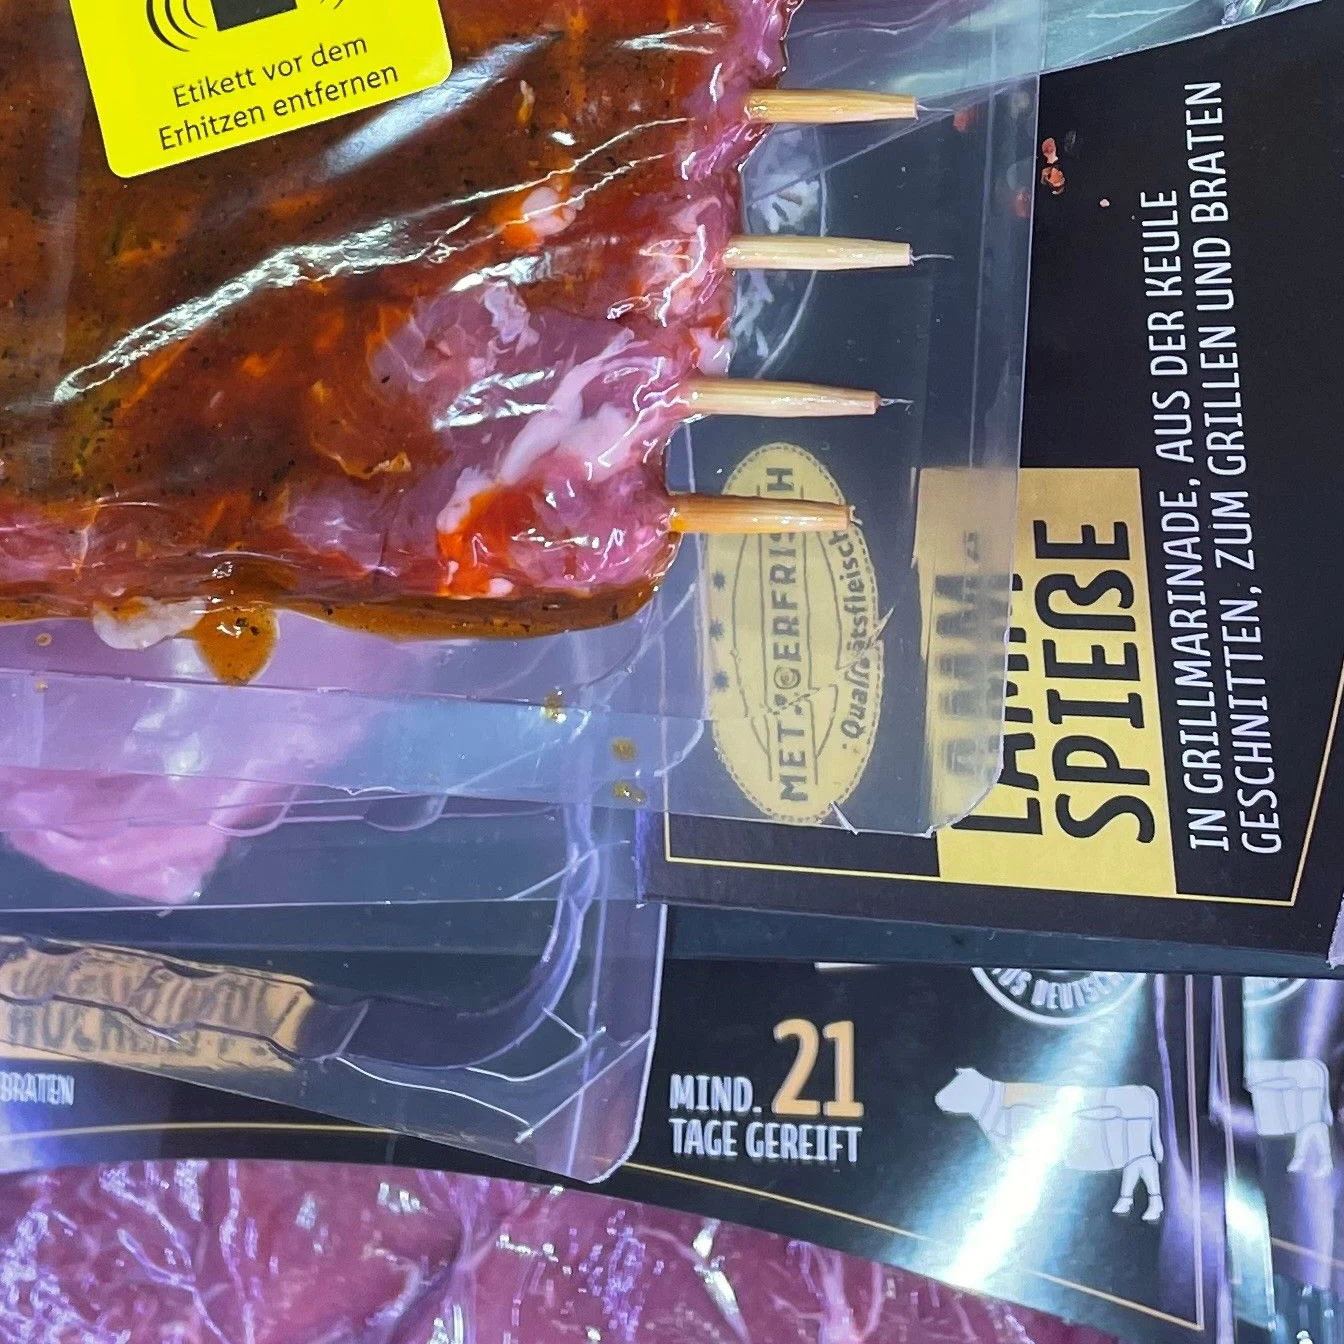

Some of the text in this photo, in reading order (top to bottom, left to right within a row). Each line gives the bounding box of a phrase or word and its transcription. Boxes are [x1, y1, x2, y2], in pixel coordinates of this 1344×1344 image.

[159, 65, 399, 151] Erhitzen entfernen
[173, 38, 368, 108] Etikett vor dem
[1183, 81, 1283, 855] GESCHNITTEN, ZUM GRILLEN UND BRATEN
[1139, 189, 1230, 852] IN GRILLMARINADE, AUS DER KEULE
[669, 1018, 865, 1118] MIND. 21
[668, 1118, 863, 1163] TAGE GEREIFT
